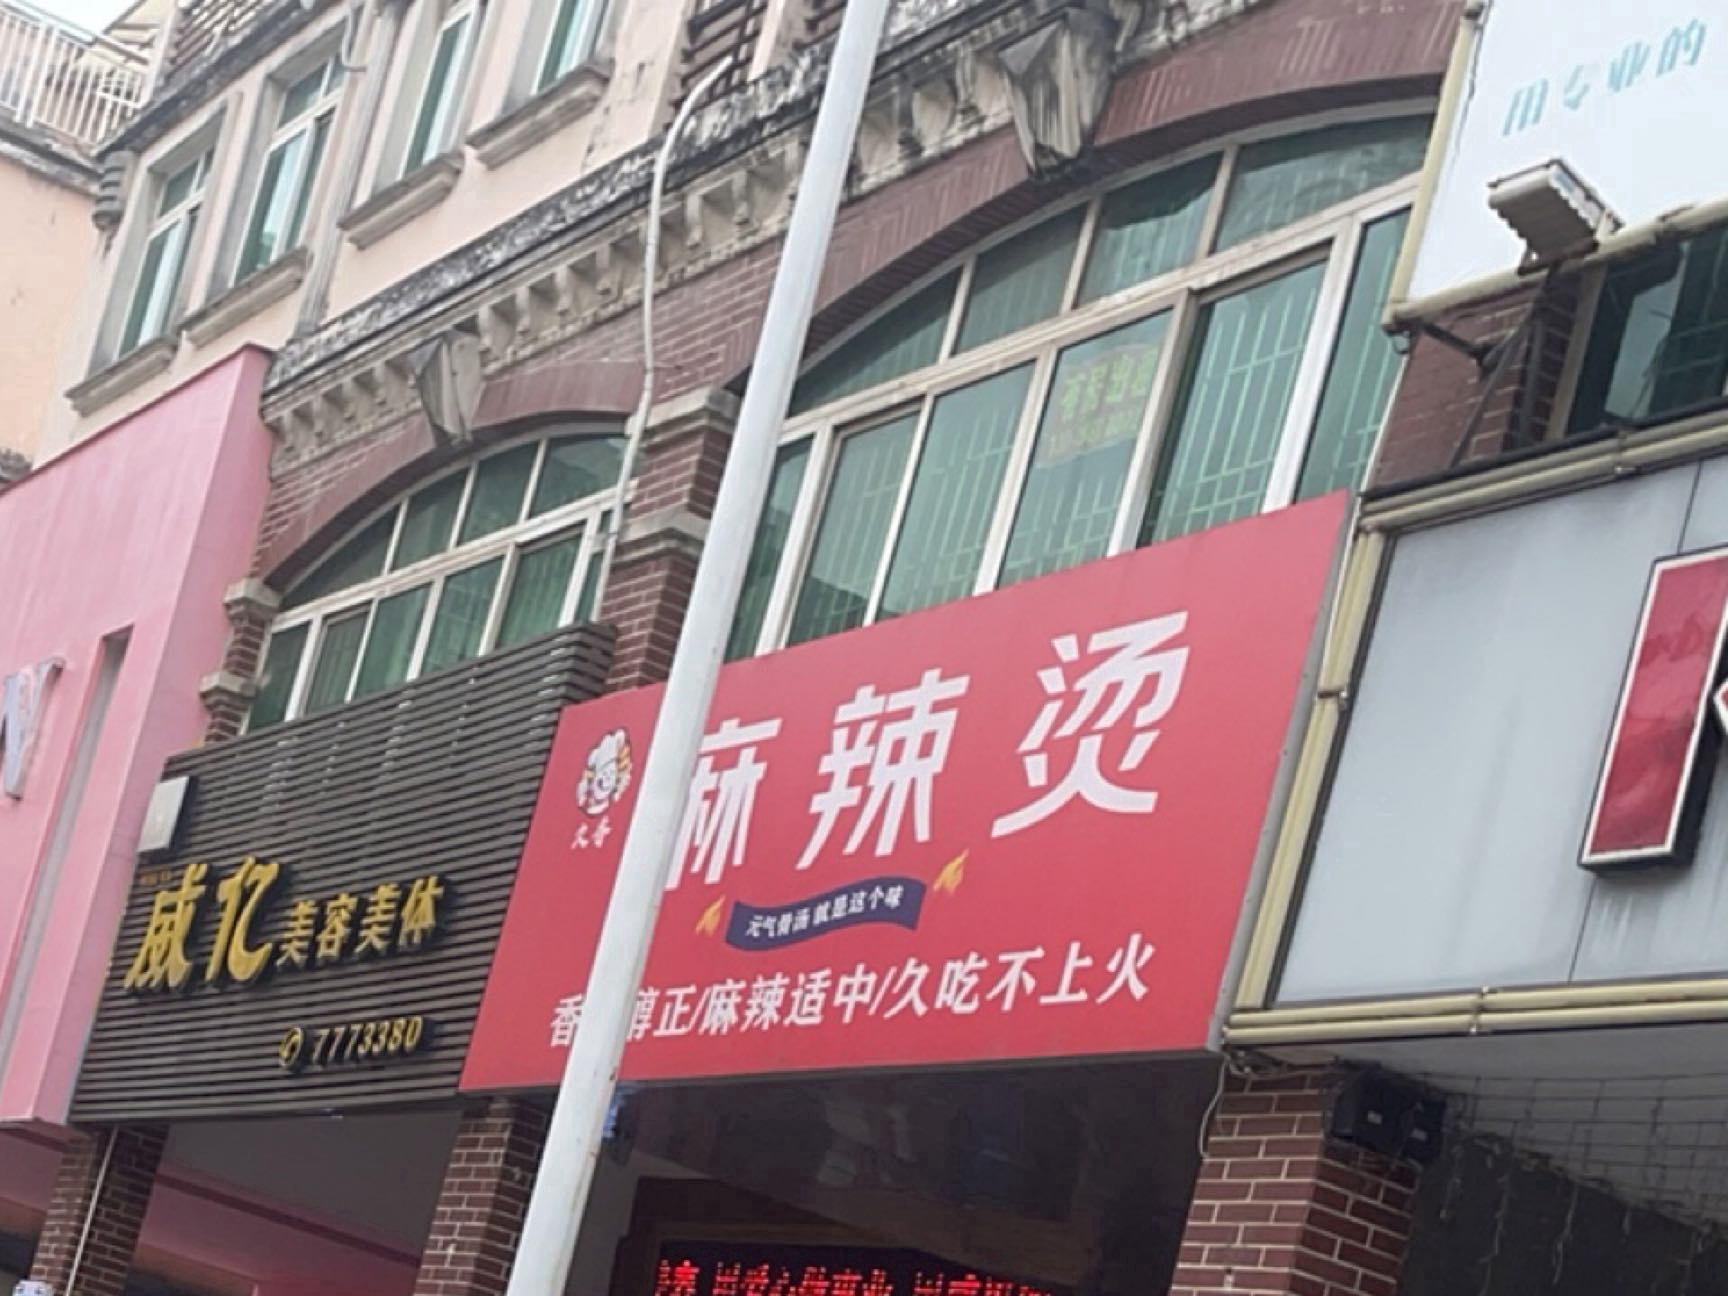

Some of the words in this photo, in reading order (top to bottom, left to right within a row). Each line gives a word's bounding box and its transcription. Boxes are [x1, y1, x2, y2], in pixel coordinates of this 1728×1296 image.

[666, 610, 1189, 890] 麻辣烫
[276, 875, 445, 968] 美容美体
[312, 1016, 425, 1065] 7773380
[550, 933, 1156, 1048] 香醇正/麻辣适中/久吃不上火
